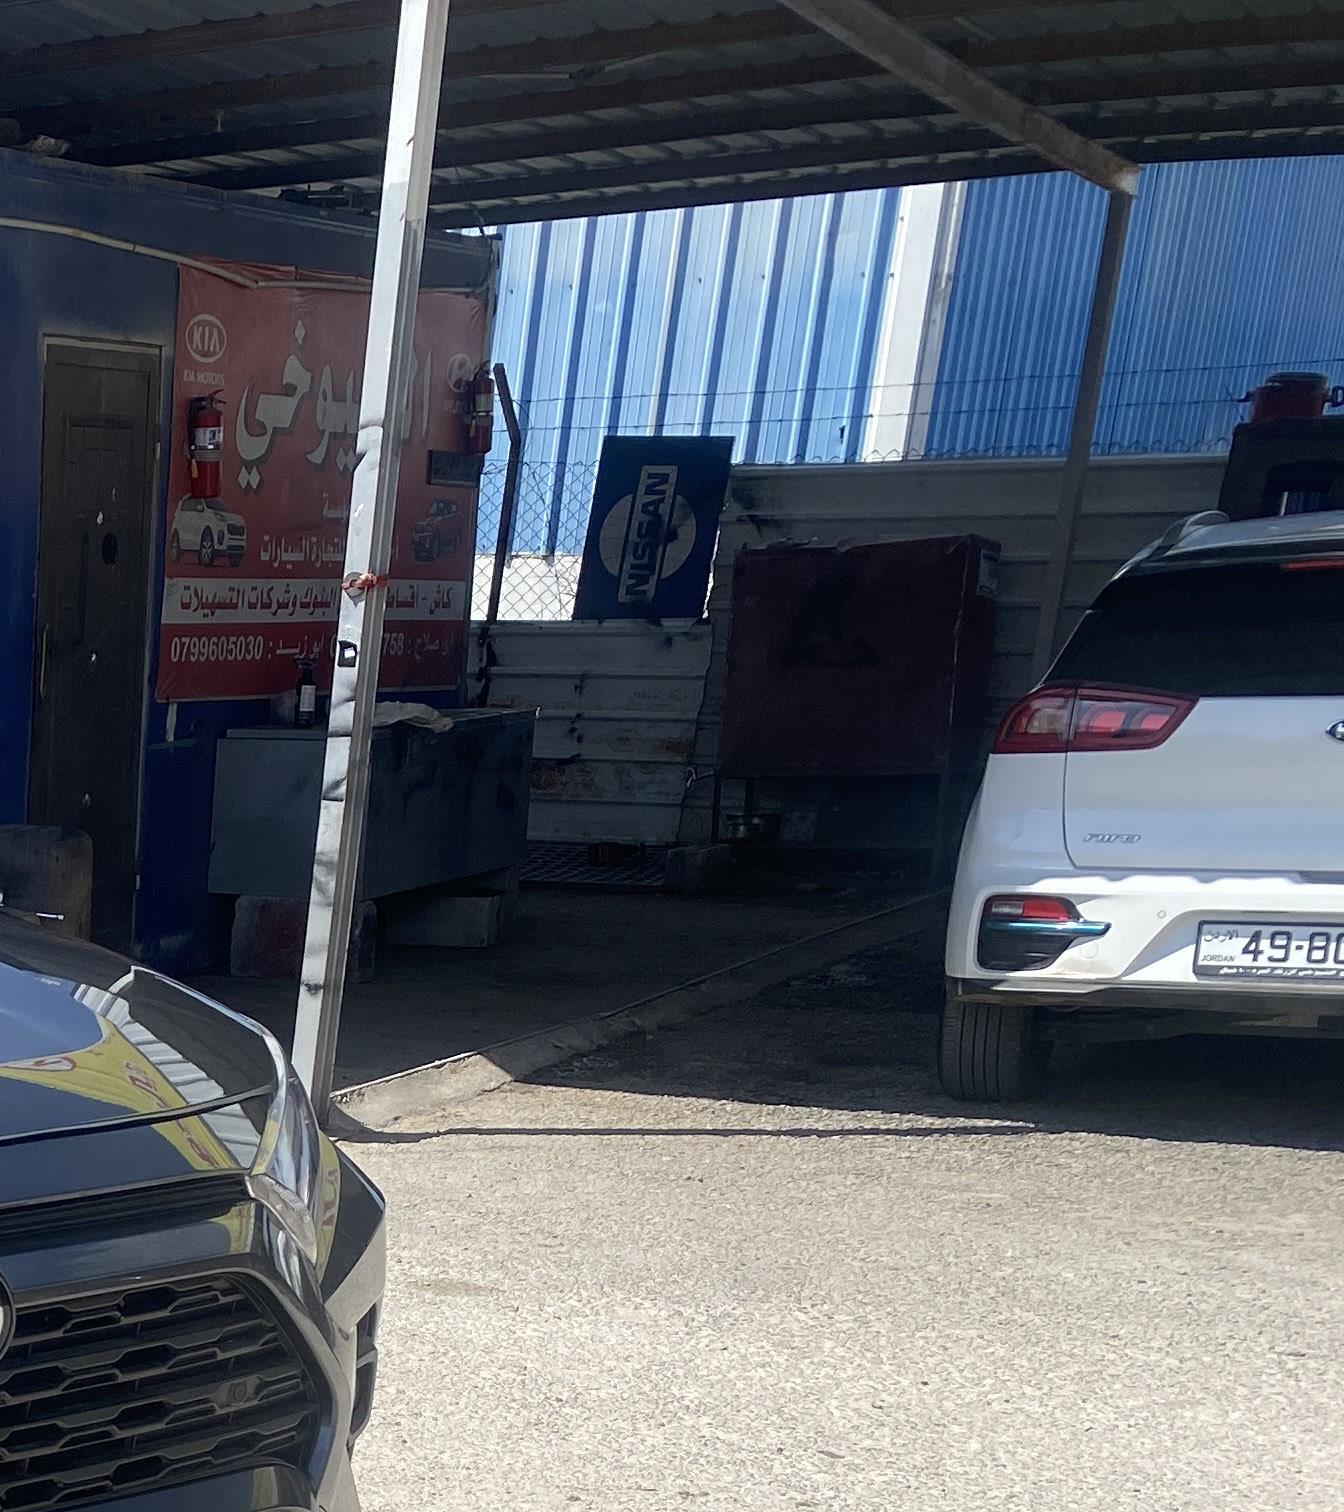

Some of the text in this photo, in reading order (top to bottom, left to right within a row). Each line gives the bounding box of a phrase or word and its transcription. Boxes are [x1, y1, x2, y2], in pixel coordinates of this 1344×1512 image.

[193, 326, 220, 352] KIA
[625, 472, 671, 597] NISSAN
[171, 635, 264, 663] 0799605030
[1201, 954, 1236, 963] JORDAN
